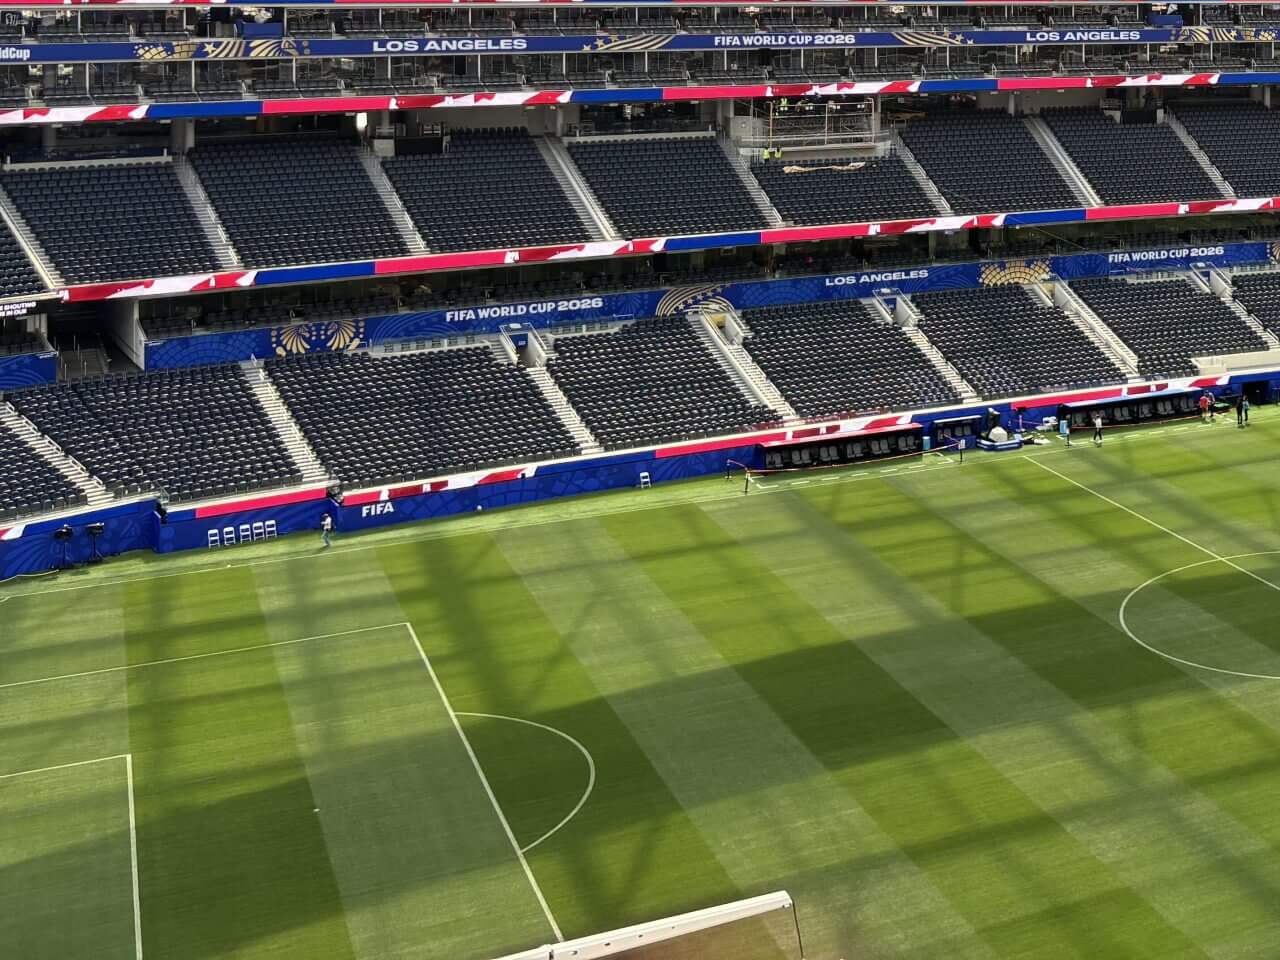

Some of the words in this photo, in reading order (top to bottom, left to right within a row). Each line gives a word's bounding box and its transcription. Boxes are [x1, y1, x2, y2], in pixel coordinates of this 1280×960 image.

[714, 36, 741, 46] FIFA
[743, 35, 787, 46] WORLD
[788, 35, 813, 45] CUP
[814, 35, 856, 44] 2026
[1026, 32, 1060, 41] LOS
[1064, 31, 1141, 40] ANGELES
[373, 40, 419, 52] LOS
[424, 39, 528, 51] ANGELES
[1108, 253, 1131, 263] FIFA
[1131, 250, 1168, 261] WORLD
[1169, 248, 1190, 258] CUP
[1190, 246, 1225, 257] 2026
[825, 276, 857, 286] LOS
[859, 269, 929, 284] ANGELES
[445, 310, 476, 322] FIFA
[477, 305, 527, 319] WORLD
[528, 302, 556, 314] CUP
[557, 297, 604, 311] 2026
[361, 501, 395, 518] FIFA
